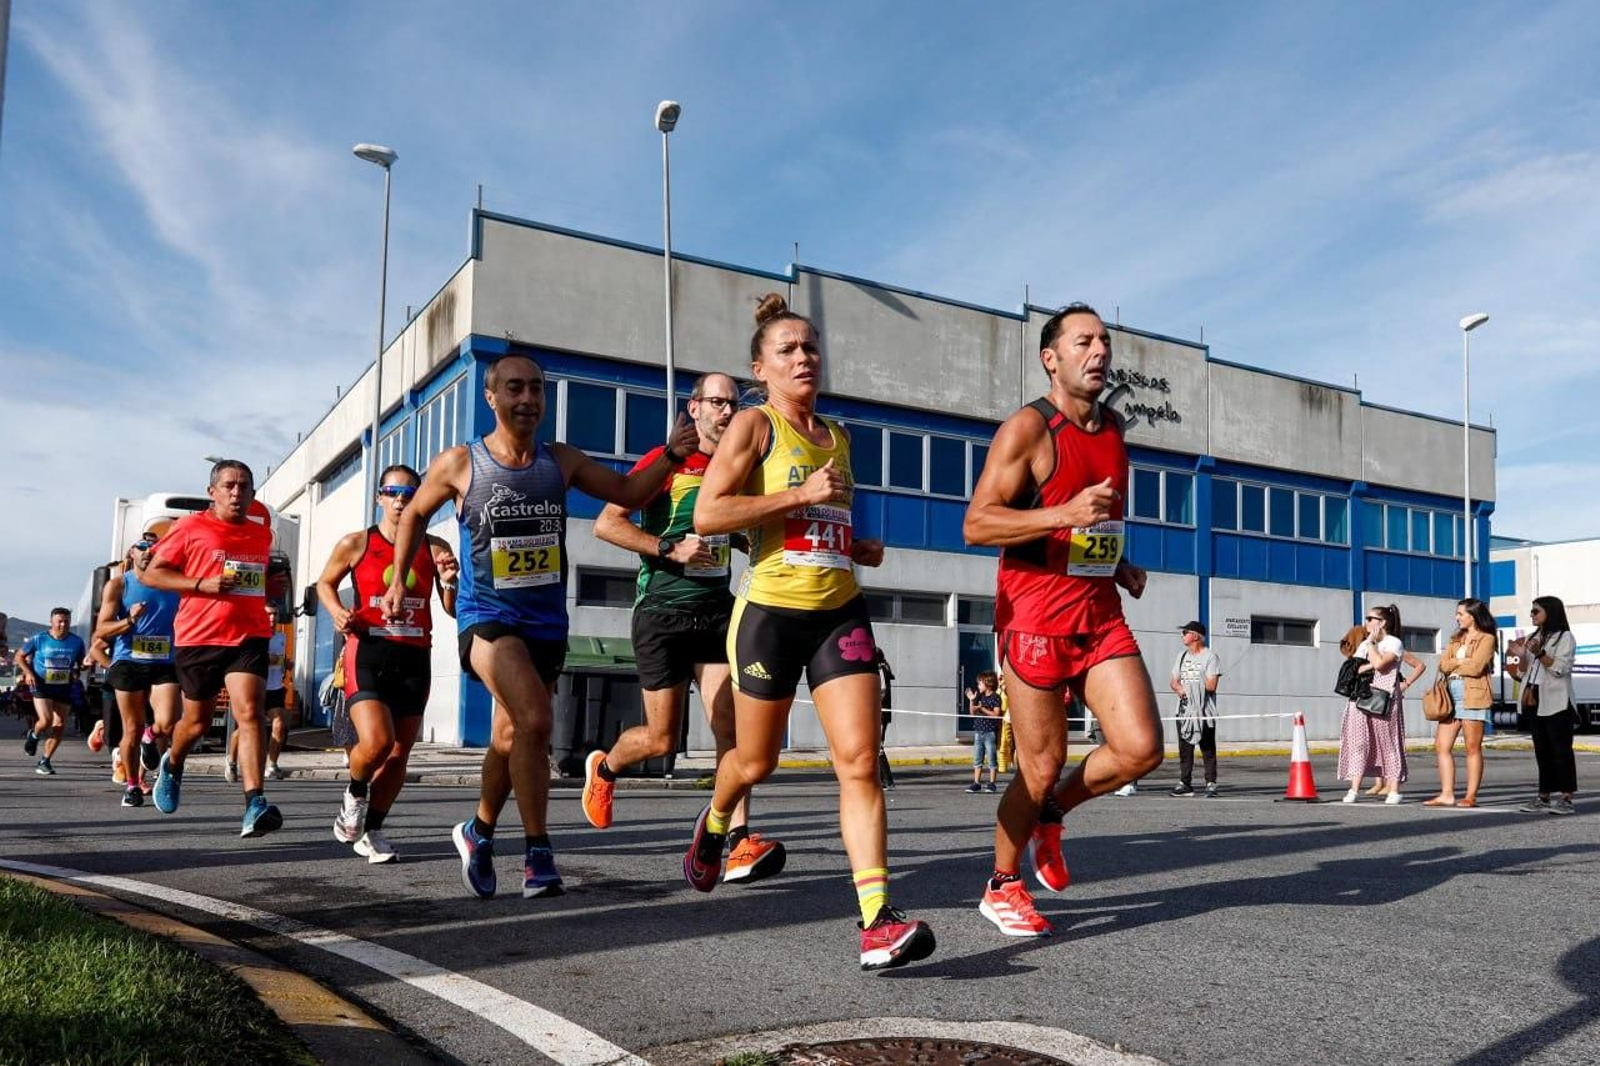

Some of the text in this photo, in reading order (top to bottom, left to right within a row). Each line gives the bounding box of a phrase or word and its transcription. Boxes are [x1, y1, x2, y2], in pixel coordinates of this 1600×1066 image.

[804, 522, 845, 550] 441
[1084, 537, 1118, 559] 259
[508, 550, 549, 572] 252
[235, 571, 260, 587] 240
[141, 642, 162, 652] 184
